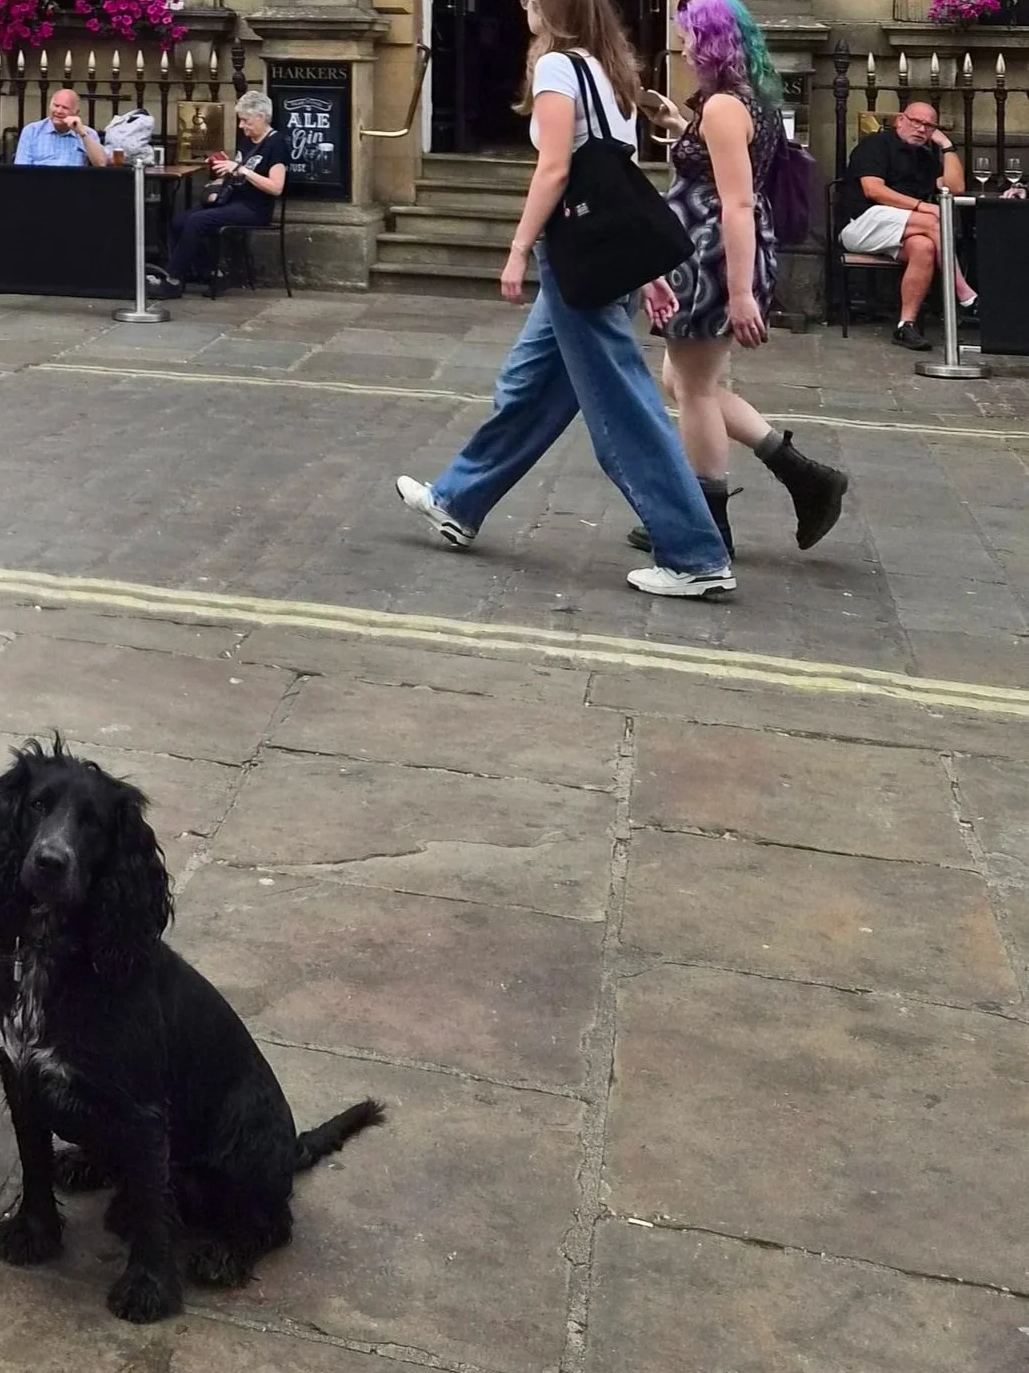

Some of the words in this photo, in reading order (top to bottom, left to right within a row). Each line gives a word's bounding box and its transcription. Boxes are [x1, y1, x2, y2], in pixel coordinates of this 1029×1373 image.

[272, 66, 347, 80] HARKERS
[287, 112, 330, 128] ALE
[291, 128, 323, 160] Gin
